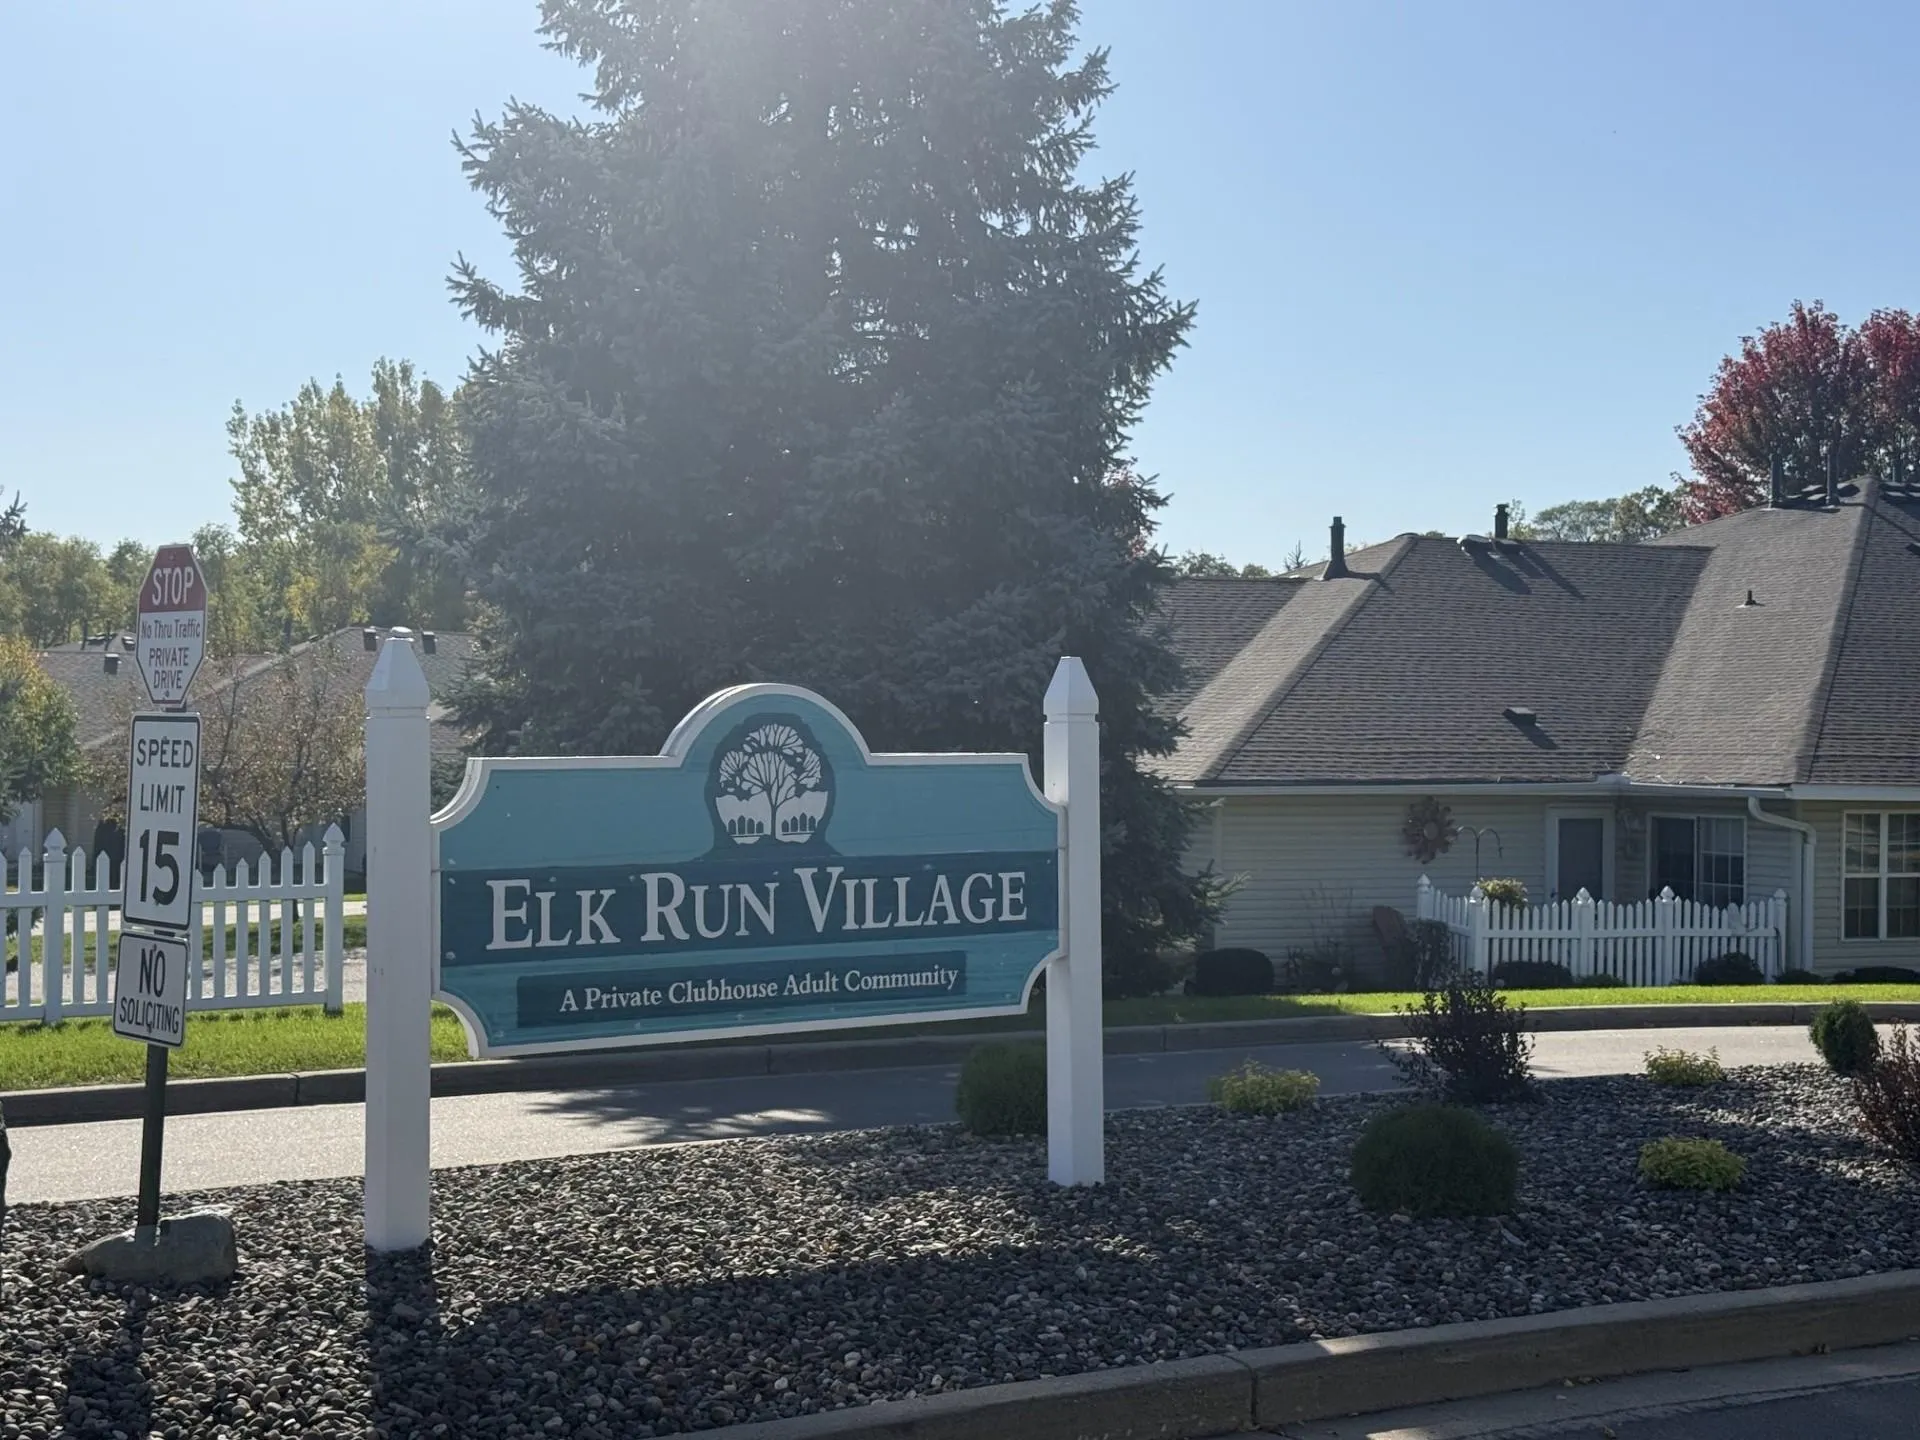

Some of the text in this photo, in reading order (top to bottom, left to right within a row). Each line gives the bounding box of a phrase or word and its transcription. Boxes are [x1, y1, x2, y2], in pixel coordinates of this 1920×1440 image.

[152, 566, 194, 606] STOP
[141, 618, 201, 639] No Thru Traffic
[149, 647, 189, 667] PRIVATE
[153, 670, 183, 689] DRIVE
[136, 738, 194, 769] SPEED
[140, 783, 186, 815] LIMIT
[139, 829, 180, 906] 15
[485, 865, 1028, 951] ELK RUN VILLAGE
[139, 947, 167, 999] NO
[559, 964, 960, 1012] A Private Clubhouse Adult Community
[119, 996, 181, 1035] SOLICITING
